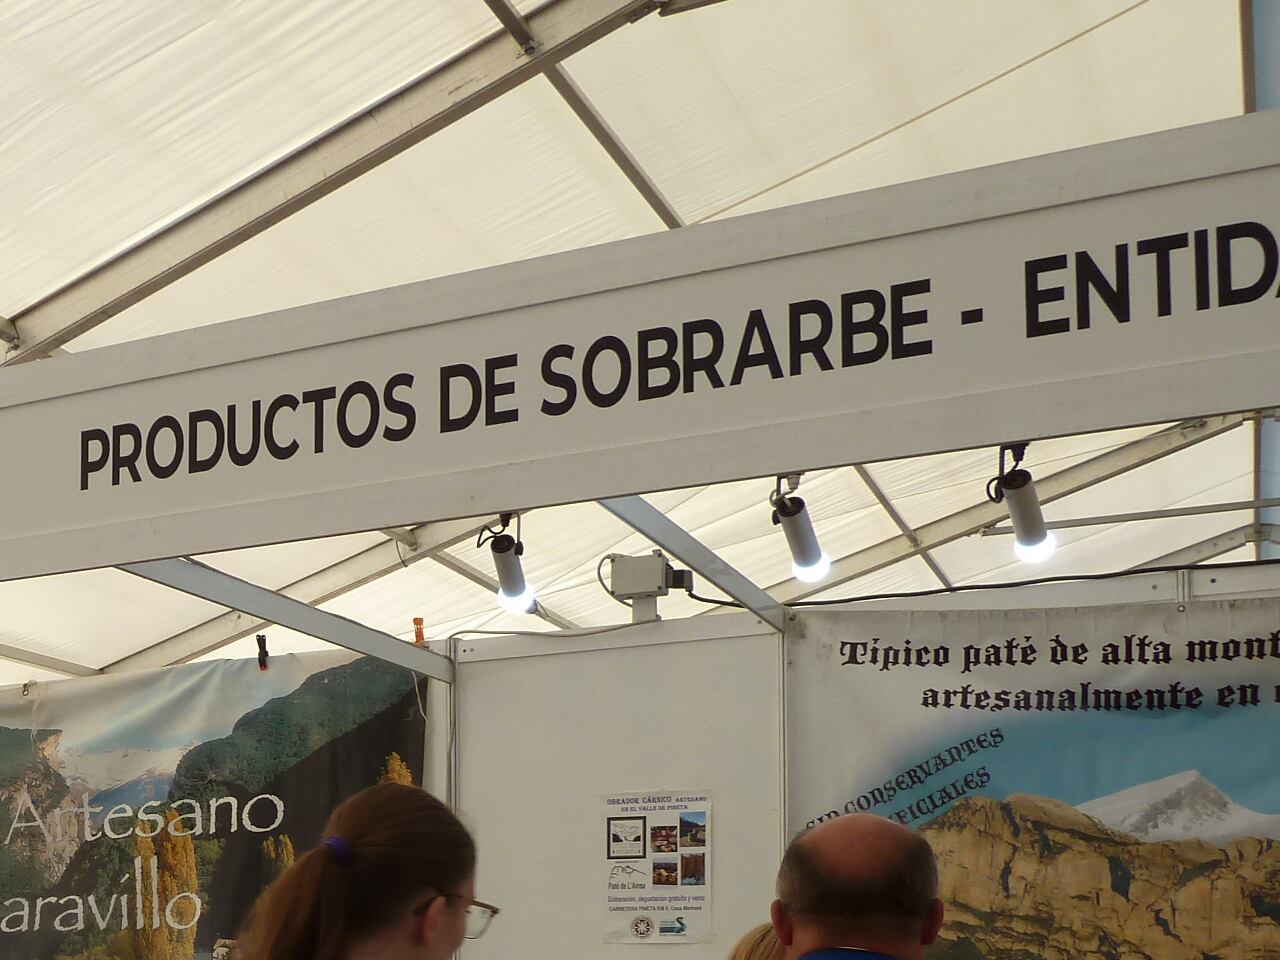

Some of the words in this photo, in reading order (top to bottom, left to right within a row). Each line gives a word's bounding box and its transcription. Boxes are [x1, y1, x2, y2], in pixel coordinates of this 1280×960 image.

[80, 372, 416, 491] PRODUCTOS
[440, 353, 519, 433] DE
[541, 278, 932, 417] SOBRARBE
[1025, 221, 1280, 338] ENTID
[840, 637, 950, 671] Típico
[961, 635, 1037, 673] paté
[1049, 634, 1089, 665] de
[1100, 634, 1173, 665] alta
[920, 681, 1204, 712] artesanalmente
[1216, 683, 1261, 707] en
[843, 727, 1005, 813] CONSERVANTES
[887, 766, 991, 825] FICIALES
[4, 787, 285, 846] Artesano
